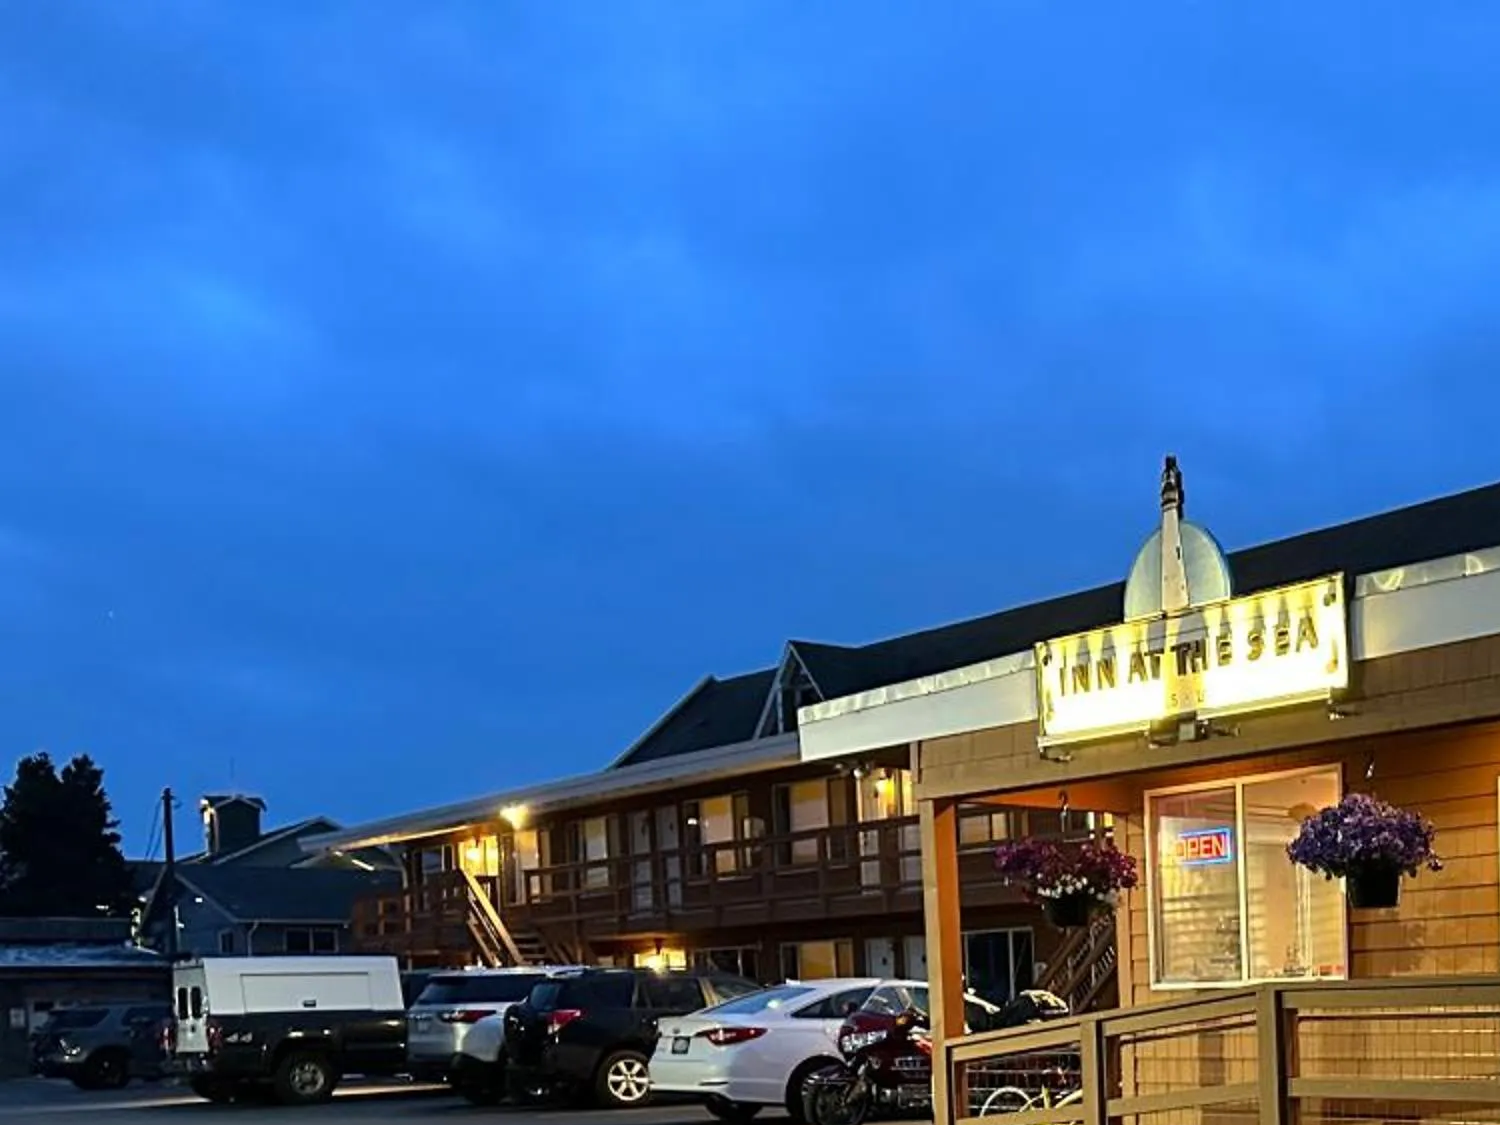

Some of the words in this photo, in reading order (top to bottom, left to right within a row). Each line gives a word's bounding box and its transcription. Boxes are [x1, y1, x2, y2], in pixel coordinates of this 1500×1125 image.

[1059, 657, 1116, 697] INN
[1127, 648, 1165, 684] AT
[1170, 633, 1233, 676] THE
[1246, 613, 1318, 661] SEA
[1174, 833, 1225, 858] OPEN
